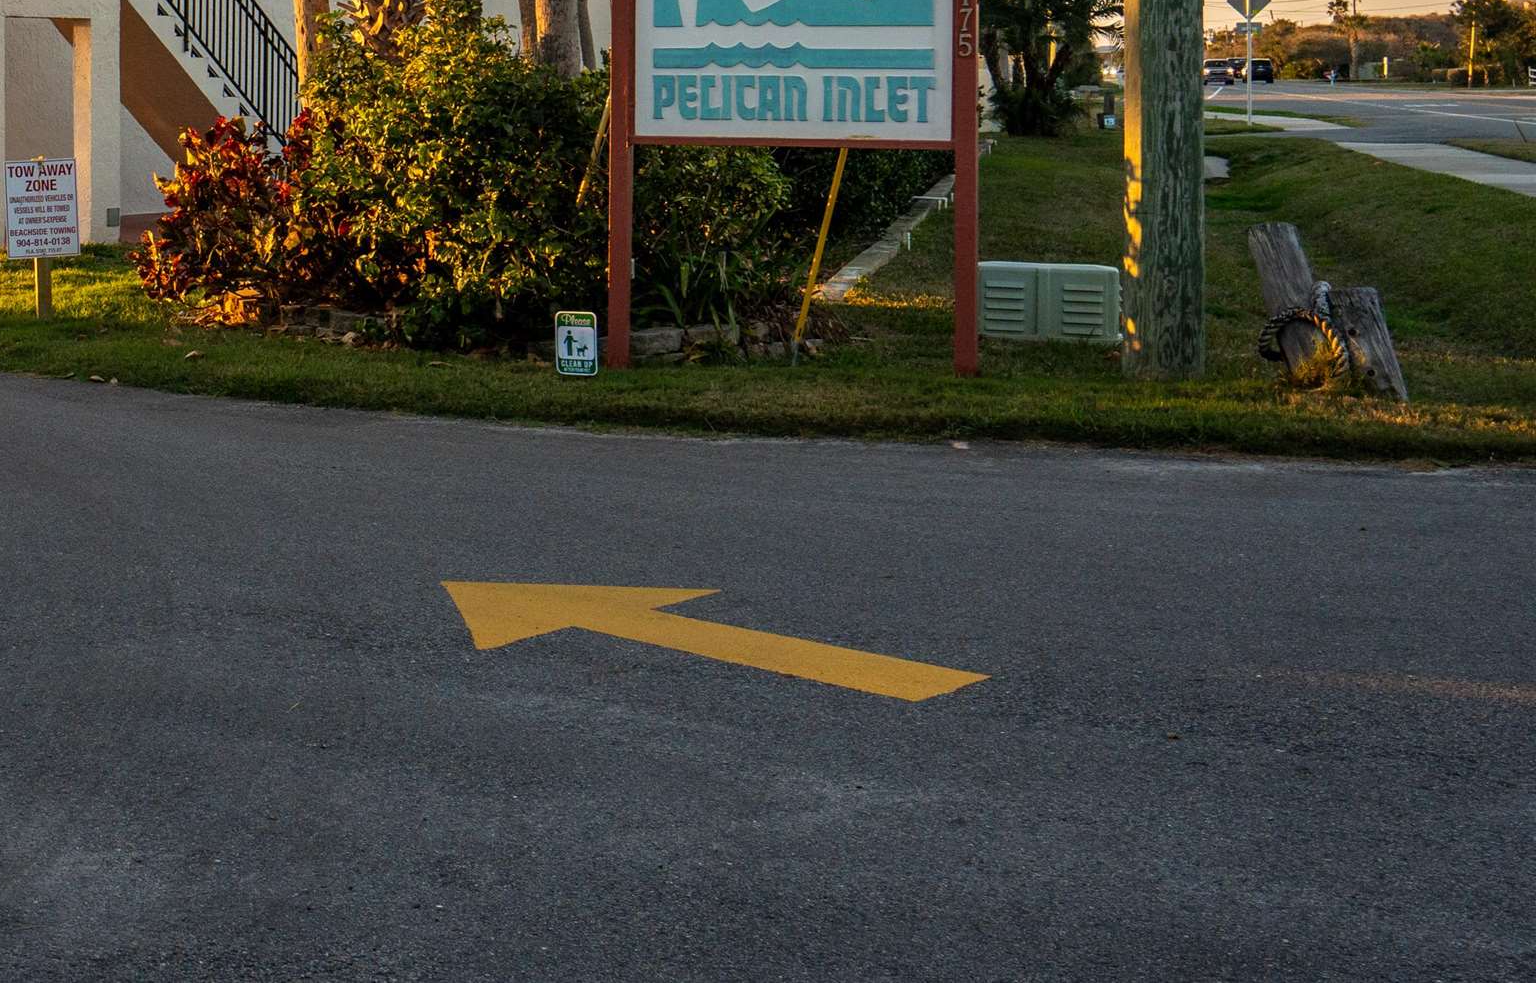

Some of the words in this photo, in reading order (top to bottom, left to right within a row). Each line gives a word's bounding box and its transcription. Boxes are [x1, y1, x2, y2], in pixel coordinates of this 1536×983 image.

[652, 74, 808, 122] PELICAN
[822, 75, 936, 124] INLET
[7, 165, 35, 178] TOW
[38, 163, 73, 177] AWAY
[25, 179, 57, 192] ZONE
[9, 195, 44, 203] UNAUTHORIZED
[45, 194, 66, 202] VEHICLES
[14, 206, 33, 214] VESSELS
[35, 205, 45, 213] WILL
[54, 204, 71, 212] TOWED
[9, 227, 49, 237] BEACHSIDE
[50, 226, 76, 235] TOWING
[16, 236, 71, 248] 904-814-0138
[560, 360, 582, 368] CLEAN
